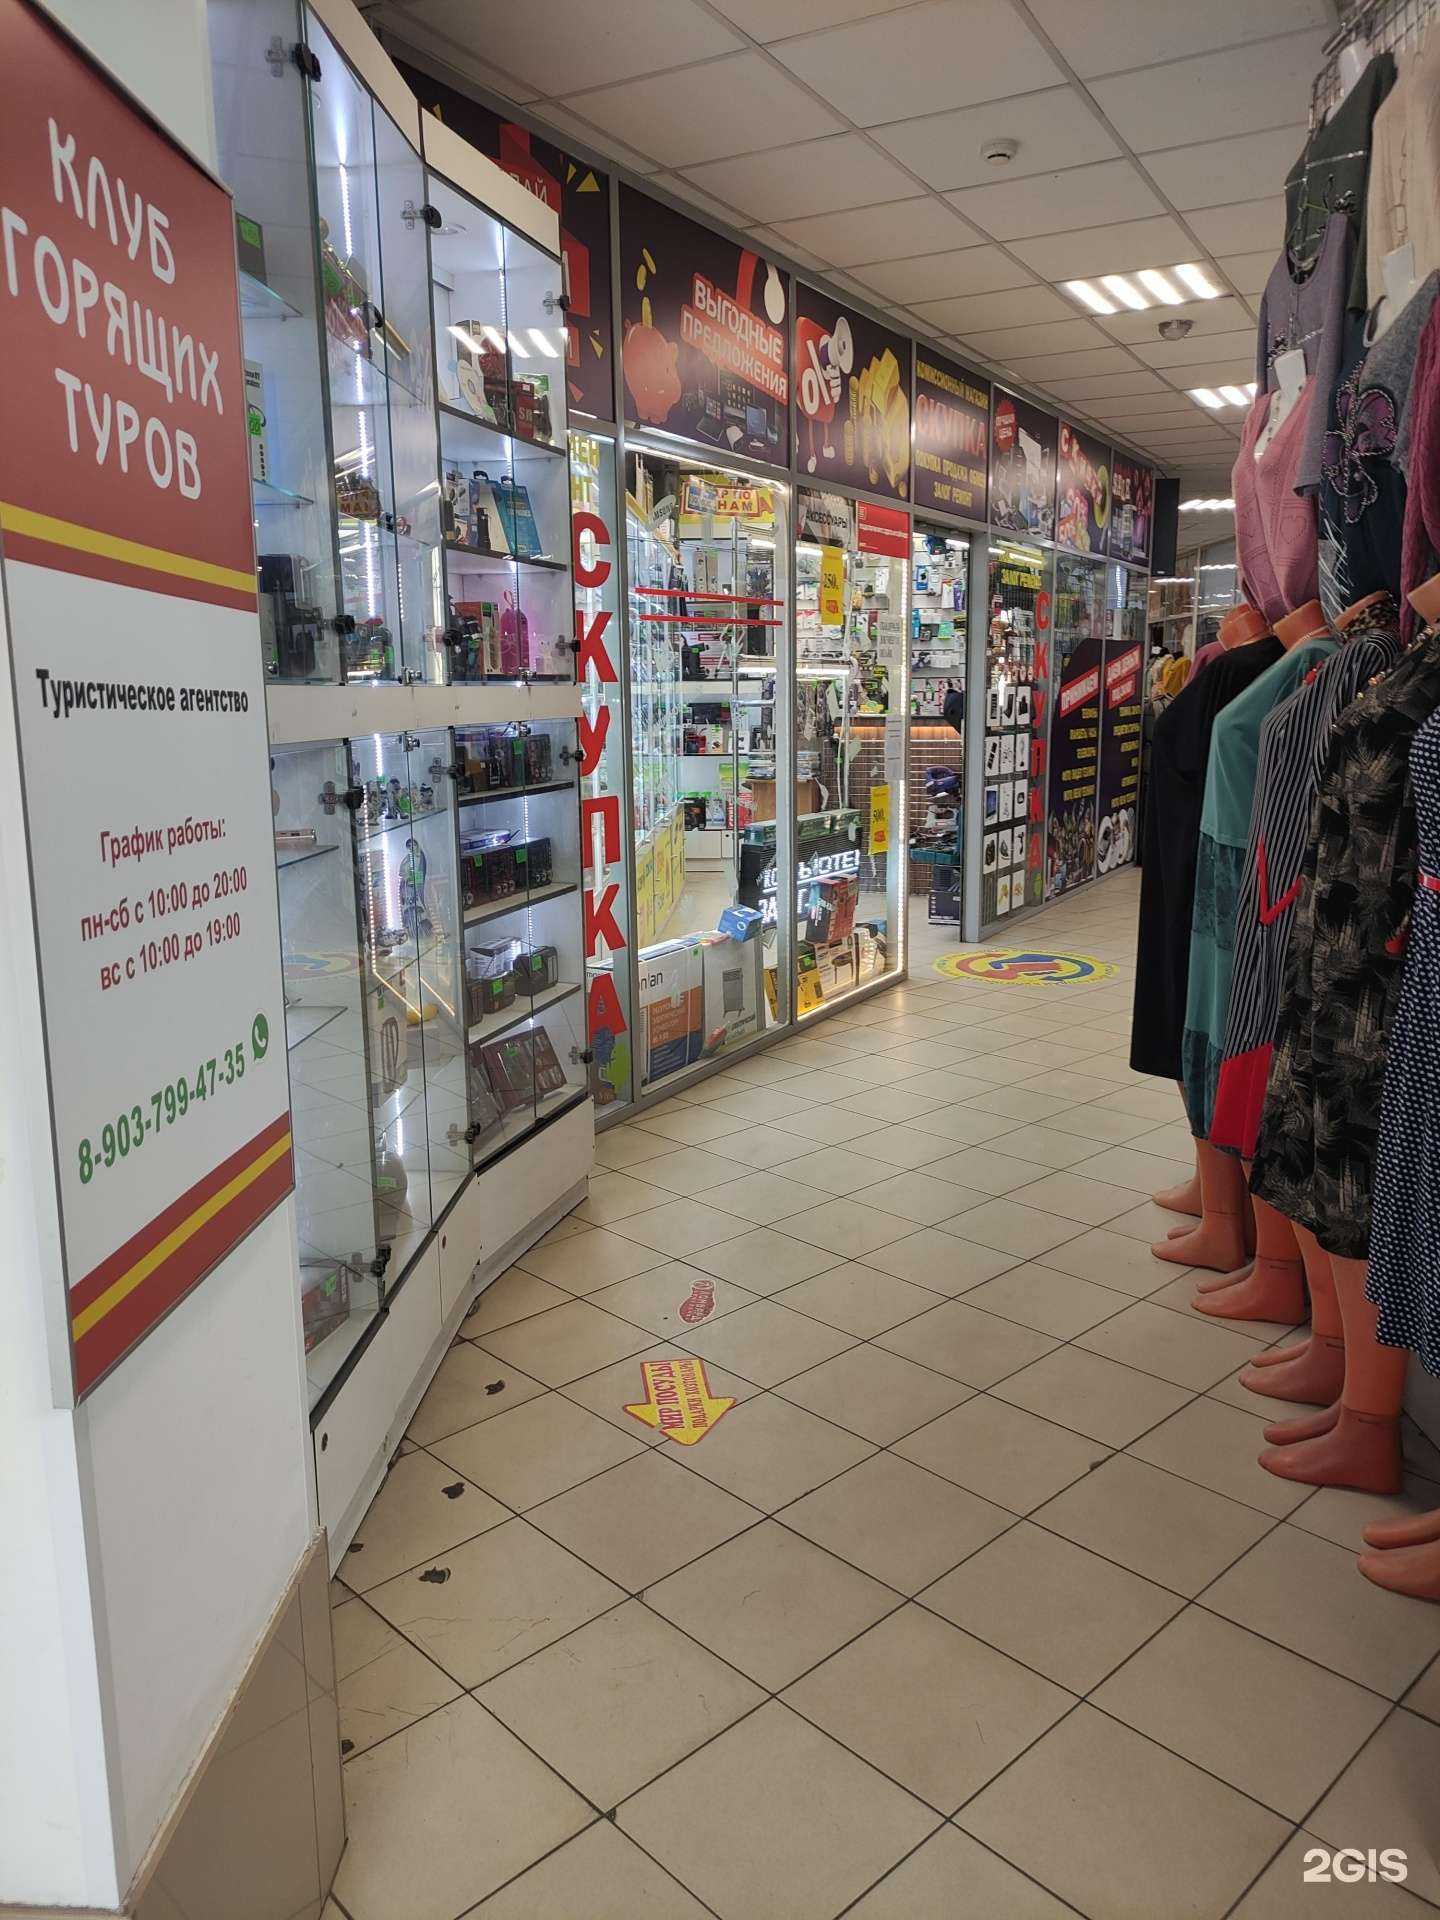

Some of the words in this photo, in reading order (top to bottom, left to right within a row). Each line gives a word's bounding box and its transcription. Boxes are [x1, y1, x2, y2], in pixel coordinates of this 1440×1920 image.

[48, 117, 175, 285] КЛУБ
[1, 206, 223, 416] ГОРЯЩИХ
[682, 309, 788, 399] ПРЕДЛОЖЕНИЯ
[694, 279, 783, 365] ВЫГОДНЫЕ
[55, 367, 201, 500] ТУРОВ
[36, 668, 175, 718] Туристическое
[180, 688, 249, 713] агентство
[1027, 591, 1051, 871] СКУПКА
[572, 511, 628, 1046] СКУПКА
[101, 825, 164, 868] График
[168, 816, 226, 856] работы:
[81, 897, 130, 942] пн-сб
[135, 899, 145, 924] с
[149, 881, 188, 920] 10:00
[192, 882, 210, 909] до
[214, 866, 247, 902] 20:00
[101, 964, 121, 991] вс
[125, 956, 136, 980] с
[140, 933, 180, 974] 10:00
[184, 935, 202, 961] до
[207, 912, 241, 950] 19:00
[79, 1042, 246, 1186] 8-903-799-47-35
[651, 1361, 680, 1405] ПОСУДЫ
[659, 1407, 685, 1431] МИР
